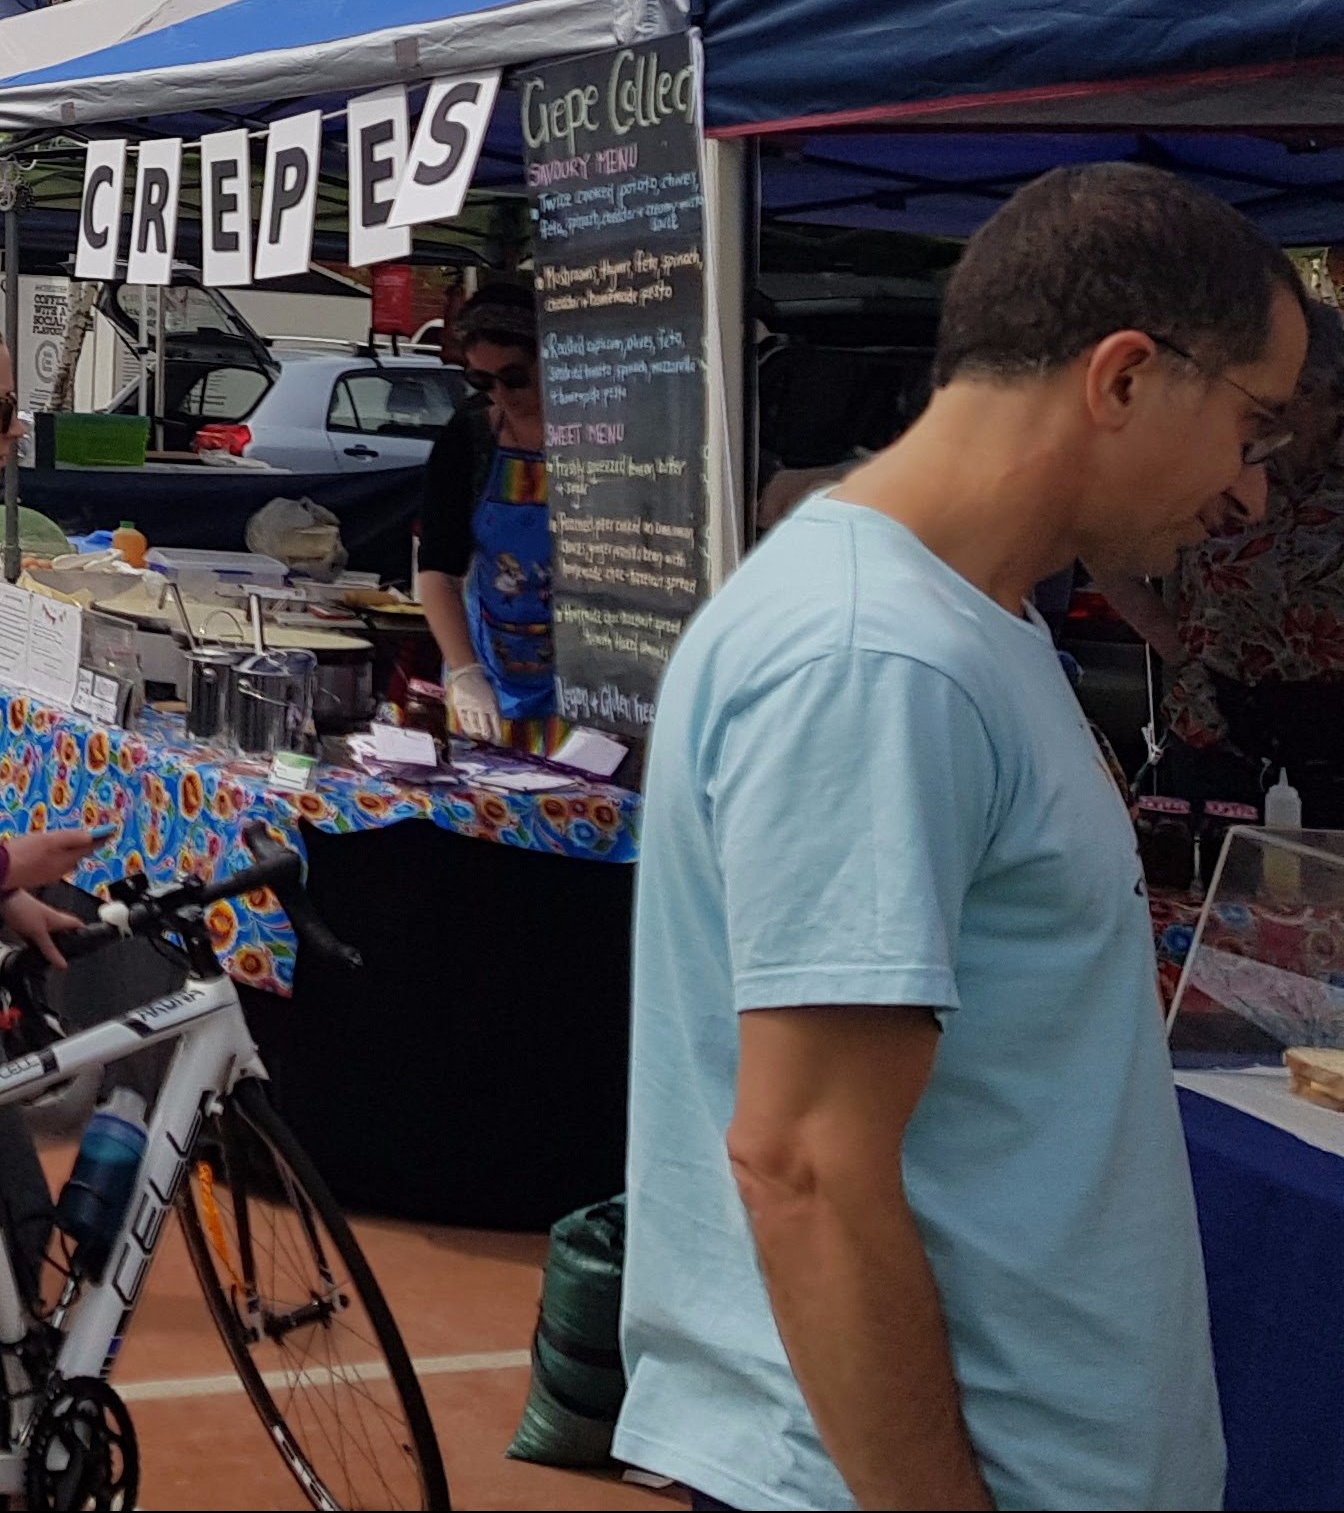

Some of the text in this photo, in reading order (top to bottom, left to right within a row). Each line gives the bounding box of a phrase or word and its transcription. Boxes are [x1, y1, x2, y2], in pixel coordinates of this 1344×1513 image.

[521, 76, 600, 155] Crepe
[83, 81, 483, 254] CREPES
[529, 142, 639, 186] SAVOURY MENU
[639, 280, 673, 307] pesto
[545, 422, 625, 447] SWEET MENU
[113, 1108, 204, 1307] CELL
